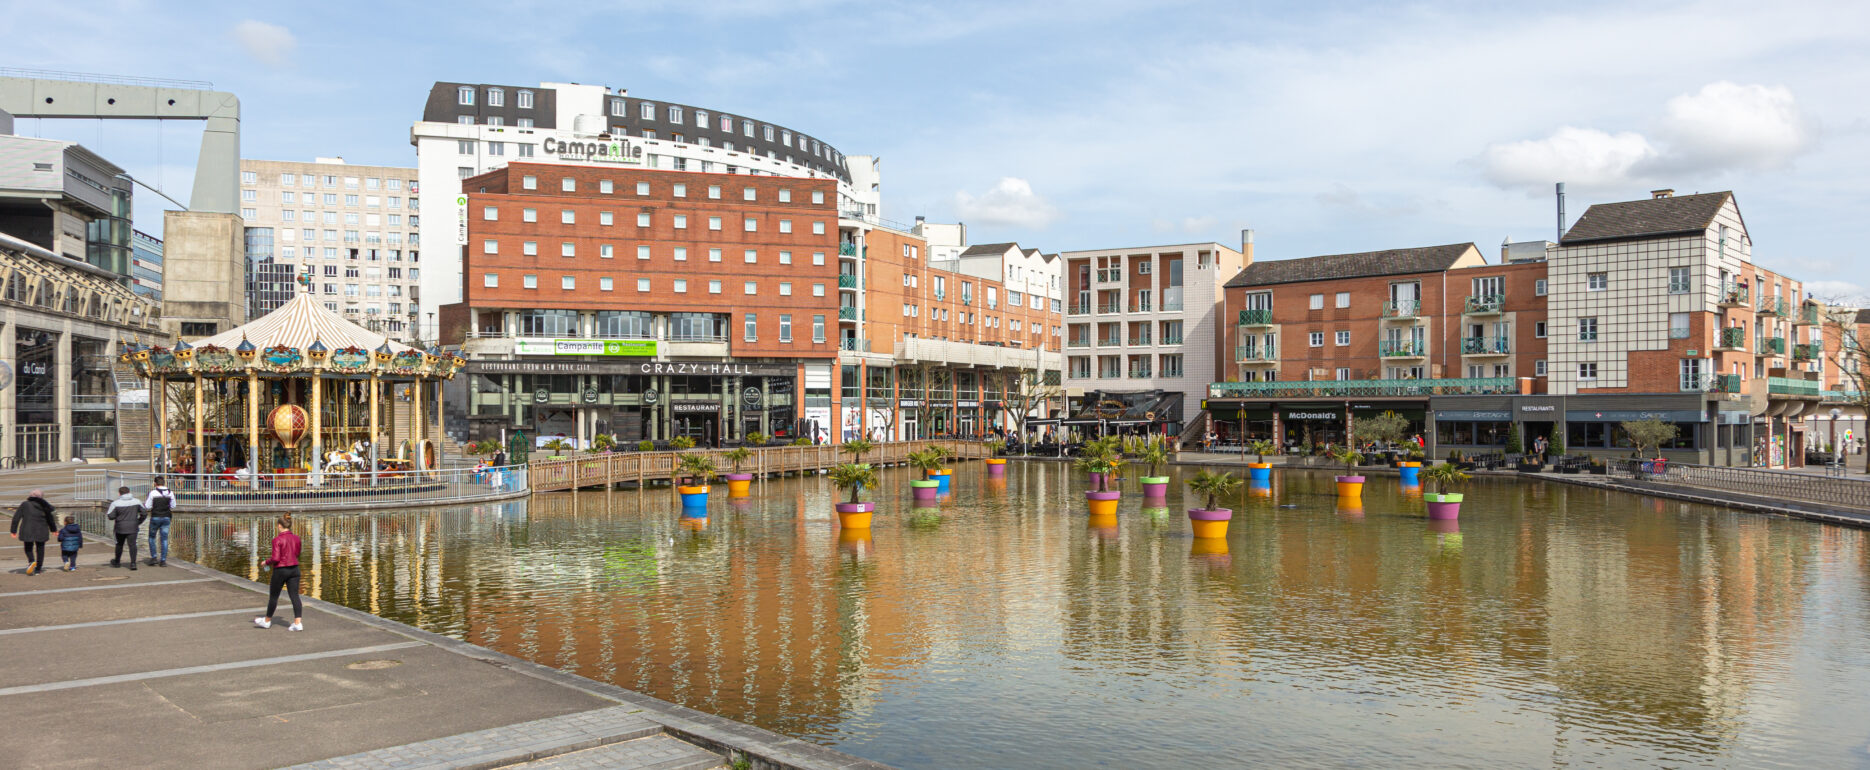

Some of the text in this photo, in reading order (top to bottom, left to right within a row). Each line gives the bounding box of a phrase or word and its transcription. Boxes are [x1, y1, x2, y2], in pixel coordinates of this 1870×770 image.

[543, 137, 642, 161] Campanile
[457, 207, 466, 242] Campanile
[557, 342, 603, 352] Campanile
[23, 361, 46, 375] du Canal
[523, 362, 540, 371] FROM
[543, 362, 555, 371] NEW
[558, 363, 574, 371] YORK
[577, 363, 591, 371] CITY
[641, 363, 752, 374] CRAZY HALL
[1288, 412, 1337, 420] McDonald's
